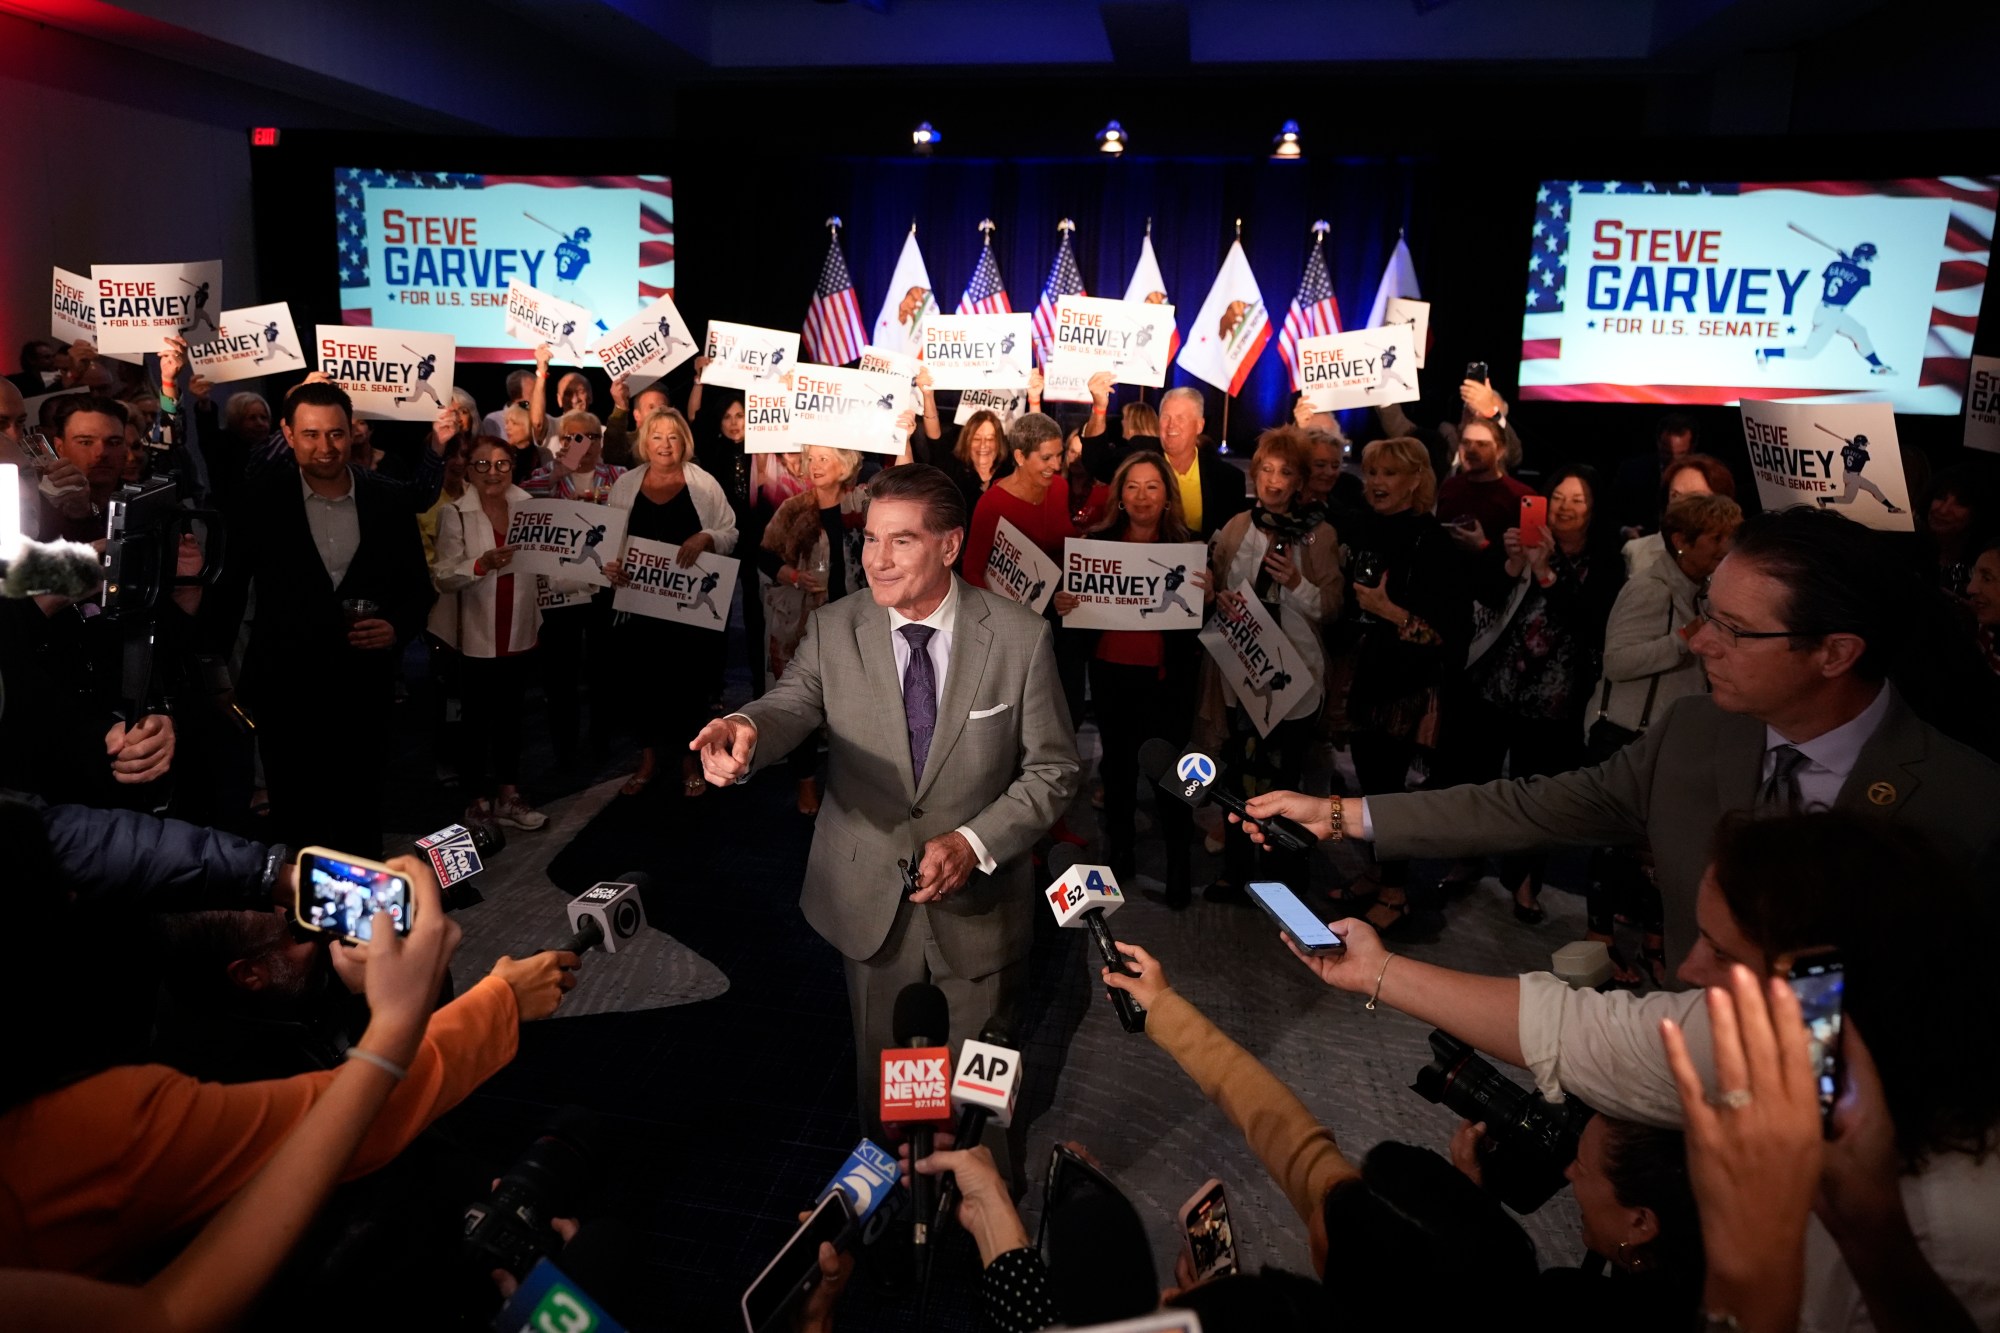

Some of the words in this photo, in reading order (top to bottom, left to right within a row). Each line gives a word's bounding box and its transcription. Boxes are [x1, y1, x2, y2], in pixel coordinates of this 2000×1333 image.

[383, 209, 477, 245] STEVE
[1593, 219, 1721, 264] STEVE
[384, 247, 545, 288] GARVEY
[560, 256, 571, 273] 6
[55, 278, 84, 303] STEVE
[99, 279, 157, 297] STEVE
[1587, 265, 1810, 316] GARVEY
[1827, 277, 1843, 297] 6
[54, 293, 96, 324] GARVE
[100, 295, 191, 318] GARVEY
[401, 291, 429, 305] FOR
[436, 292, 464, 306] U.S.
[471, 292, 508, 306] SENA
[511, 288, 539, 311] STEVE
[110, 319, 129, 327] FOR
[132, 318, 150, 327] U.S.
[153, 317, 185, 327] SENATE
[510, 300, 559, 334] GARVEY
[1061, 308, 1103, 328] STEVE
[1603, 318, 1641, 334] FOR
[1652, 320, 1688, 336] U.S.
[1699, 320, 1779, 338] SENATE
[927, 327, 967, 342] STEVE
[1059, 325, 1132, 349] GARVEY
[190, 333, 261, 359] GARVEY
[200, 356, 215, 365] FOR
[216, 353, 230, 363] U.S.
[231, 349, 259, 360] SENATE
[322, 339, 378, 361] STEVE
[599, 335, 635, 363] STEVE
[606, 332, 660, 377] GARVEY
[927, 341, 996, 360] GARVEY
[1063, 344, 1077, 352] FOR
[1094, 347, 1122, 357] SENATE
[1303, 349, 1344, 365] STEVE
[642, 349, 661, 366] SENATE
[864, 353, 891, 370] STEVE
[323, 359, 412, 383] GARVEY
[1304, 358, 1375, 383] GARVEY
[352, 382, 369, 392] U.S.
[371, 383, 405, 394] SENATE
[798, 375, 842, 396] STEVE
[1310, 382, 1324, 390] FOR
[1343, 377, 1370, 387] SENATE
[748, 394, 786, 408] STEVE
[962, 389, 1010, 411] GARVEY
[748, 408, 790, 424] GARV
[800, 412, 815, 420] FOR
[1745, 416, 1789, 447] STEVE
[1750, 439, 1834, 479] GARVEY
[1846, 455, 1855, 467] 6
[1761, 470, 1771, 482] FOR
[1788, 478, 1827, 491] SENATE
[512, 511, 553, 527] STEVE
[507, 525, 583, 548] GARVEY
[994, 530, 1022, 565] STEVE
[523, 544, 537, 552] U.S.
[539, 545, 570, 555] SENATE
[627, 547, 671, 570] STEVE
[989, 546, 1032, 597] GARVEY
[1070, 552, 1122, 574] STEVE
[622, 562, 698, 591] GARVEY
[1068, 571, 1160, 596] GARVEY
[626, 582, 642, 591] FOR
[642, 585, 657, 594] U.S.
[658, 588, 687, 600] SENATE
[1075, 594, 1093, 603] FOR
[1095, 594, 1113, 605] U.S.
[1115, 596, 1150, 605] SENATE
[1237, 650, 1258, 680] SENATE
[1184, 780, 1201, 797] abc
[430, 850, 450, 885] channel
[441, 848, 461, 882] NEWS
[454, 849, 473, 876] FOX
[1086, 870, 1106, 895] 4
[1066, 885, 1084, 906] 52
[884, 1058, 945, 1082] KNX
[963, 1053, 1009, 1082] AP
[884, 1081, 946, 1100] NEWS
[915, 1100, 931, 1108] 97.1
[932, 1099, 945, 1107] FM
[858, 1141, 896, 1178] KTLA
[539, 1291, 591, 1333] 3
